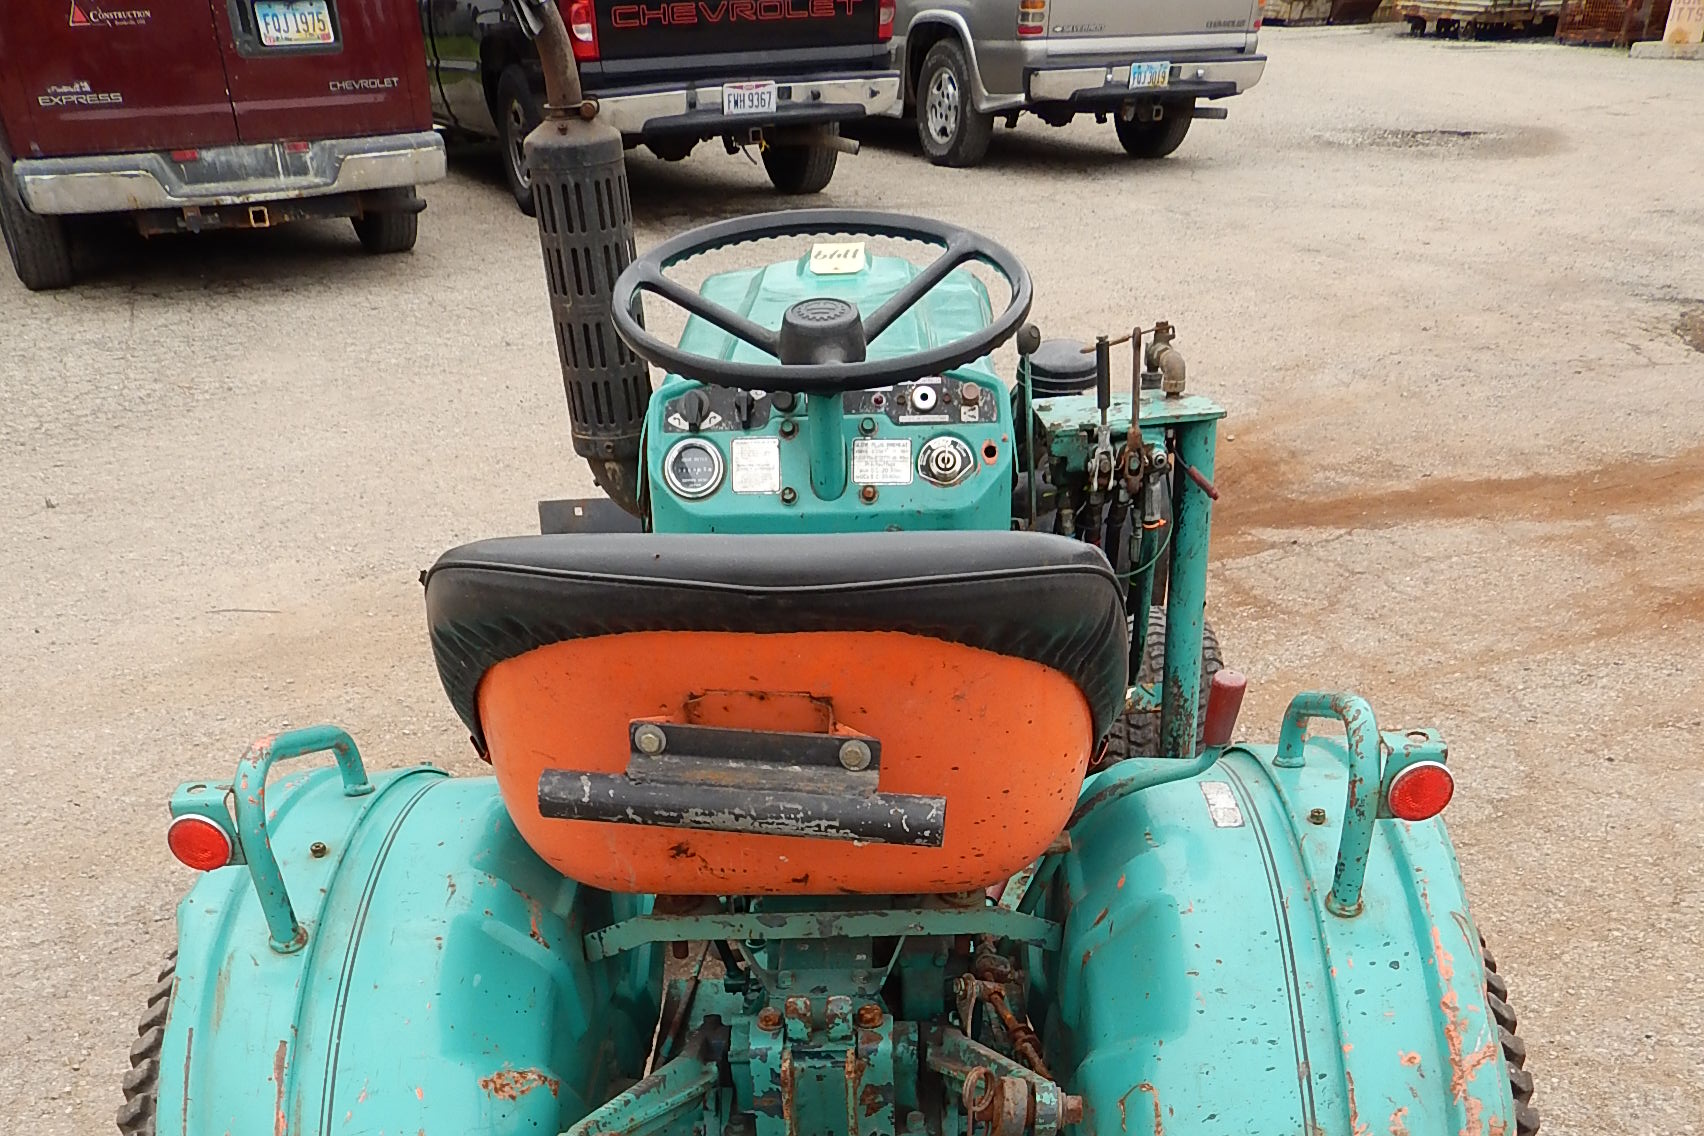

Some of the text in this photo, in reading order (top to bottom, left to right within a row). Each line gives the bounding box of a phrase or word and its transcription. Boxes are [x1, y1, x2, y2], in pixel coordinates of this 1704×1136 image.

[292, 11, 327, 34] 1975
[612, 0, 862, 27] CHEVROLET
[328, 77, 399, 91] CHEVROLET
[37, 92, 123, 106] EXPRESS
[747, 90, 772, 109] 9367
